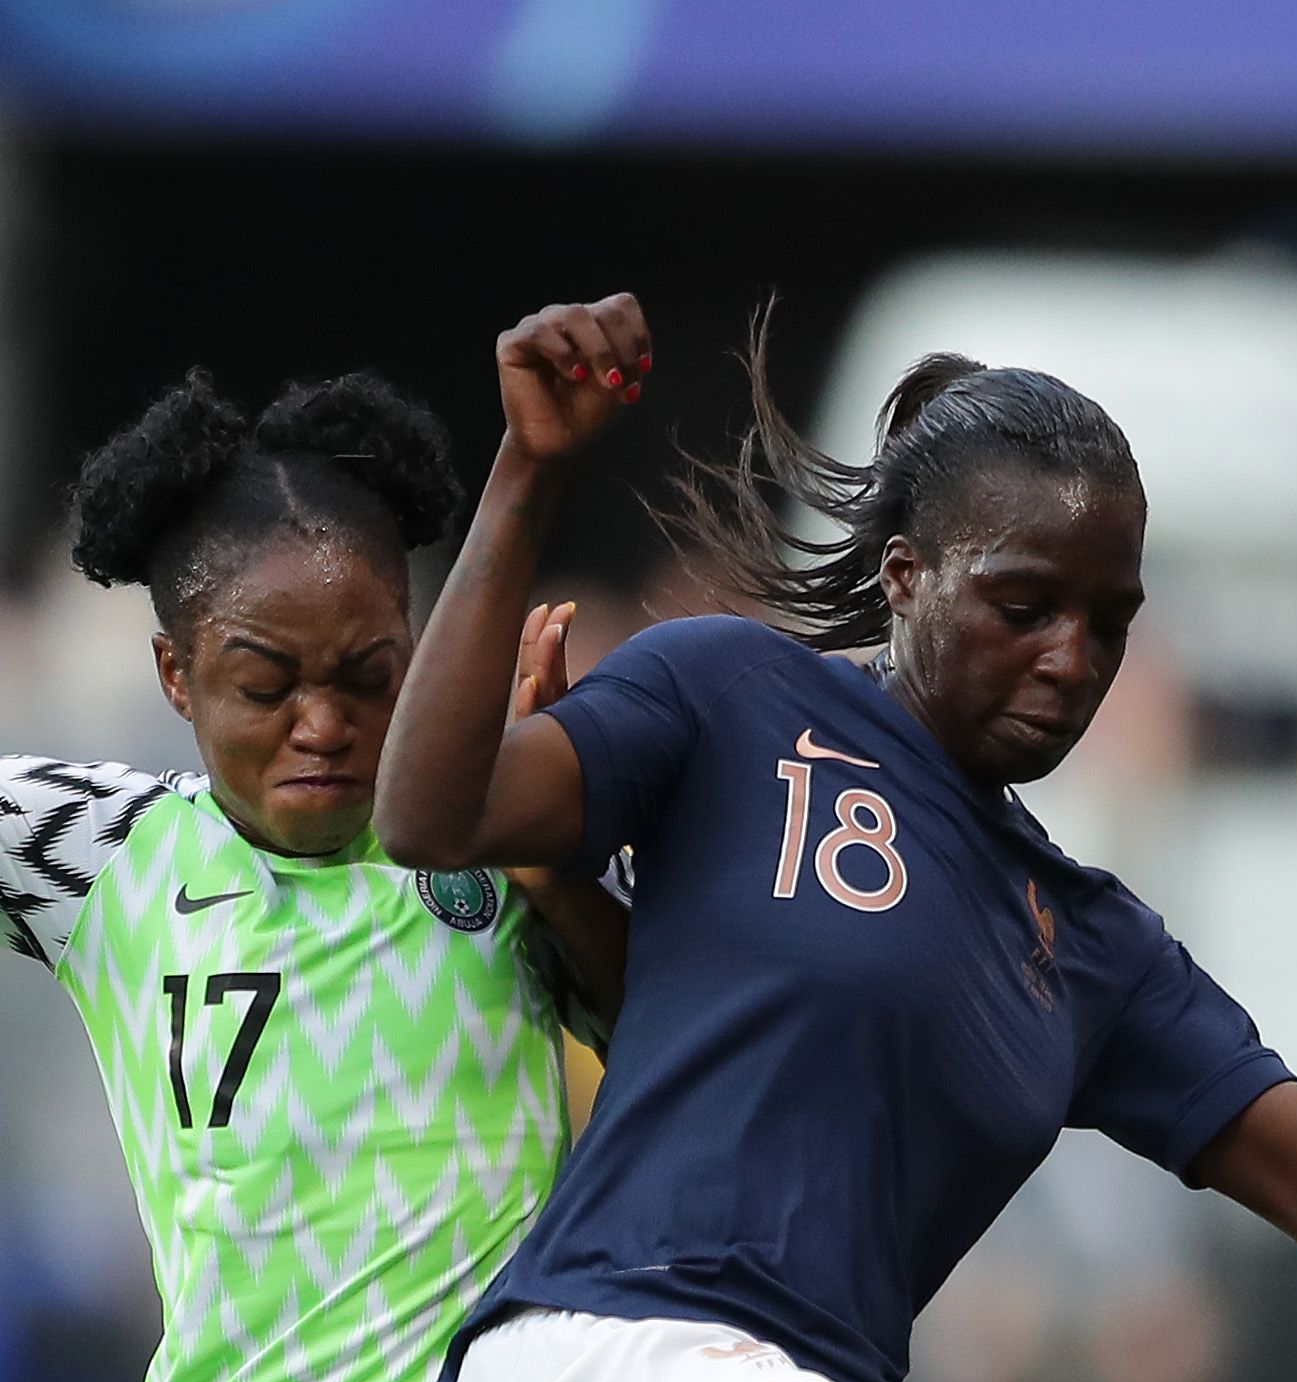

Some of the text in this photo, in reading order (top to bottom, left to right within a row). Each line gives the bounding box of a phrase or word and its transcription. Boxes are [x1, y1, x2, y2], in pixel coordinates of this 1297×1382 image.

[772, 759, 908, 913] 18
[449, 916, 484, 929] ABUJA
[162, 972, 282, 1130] 17
